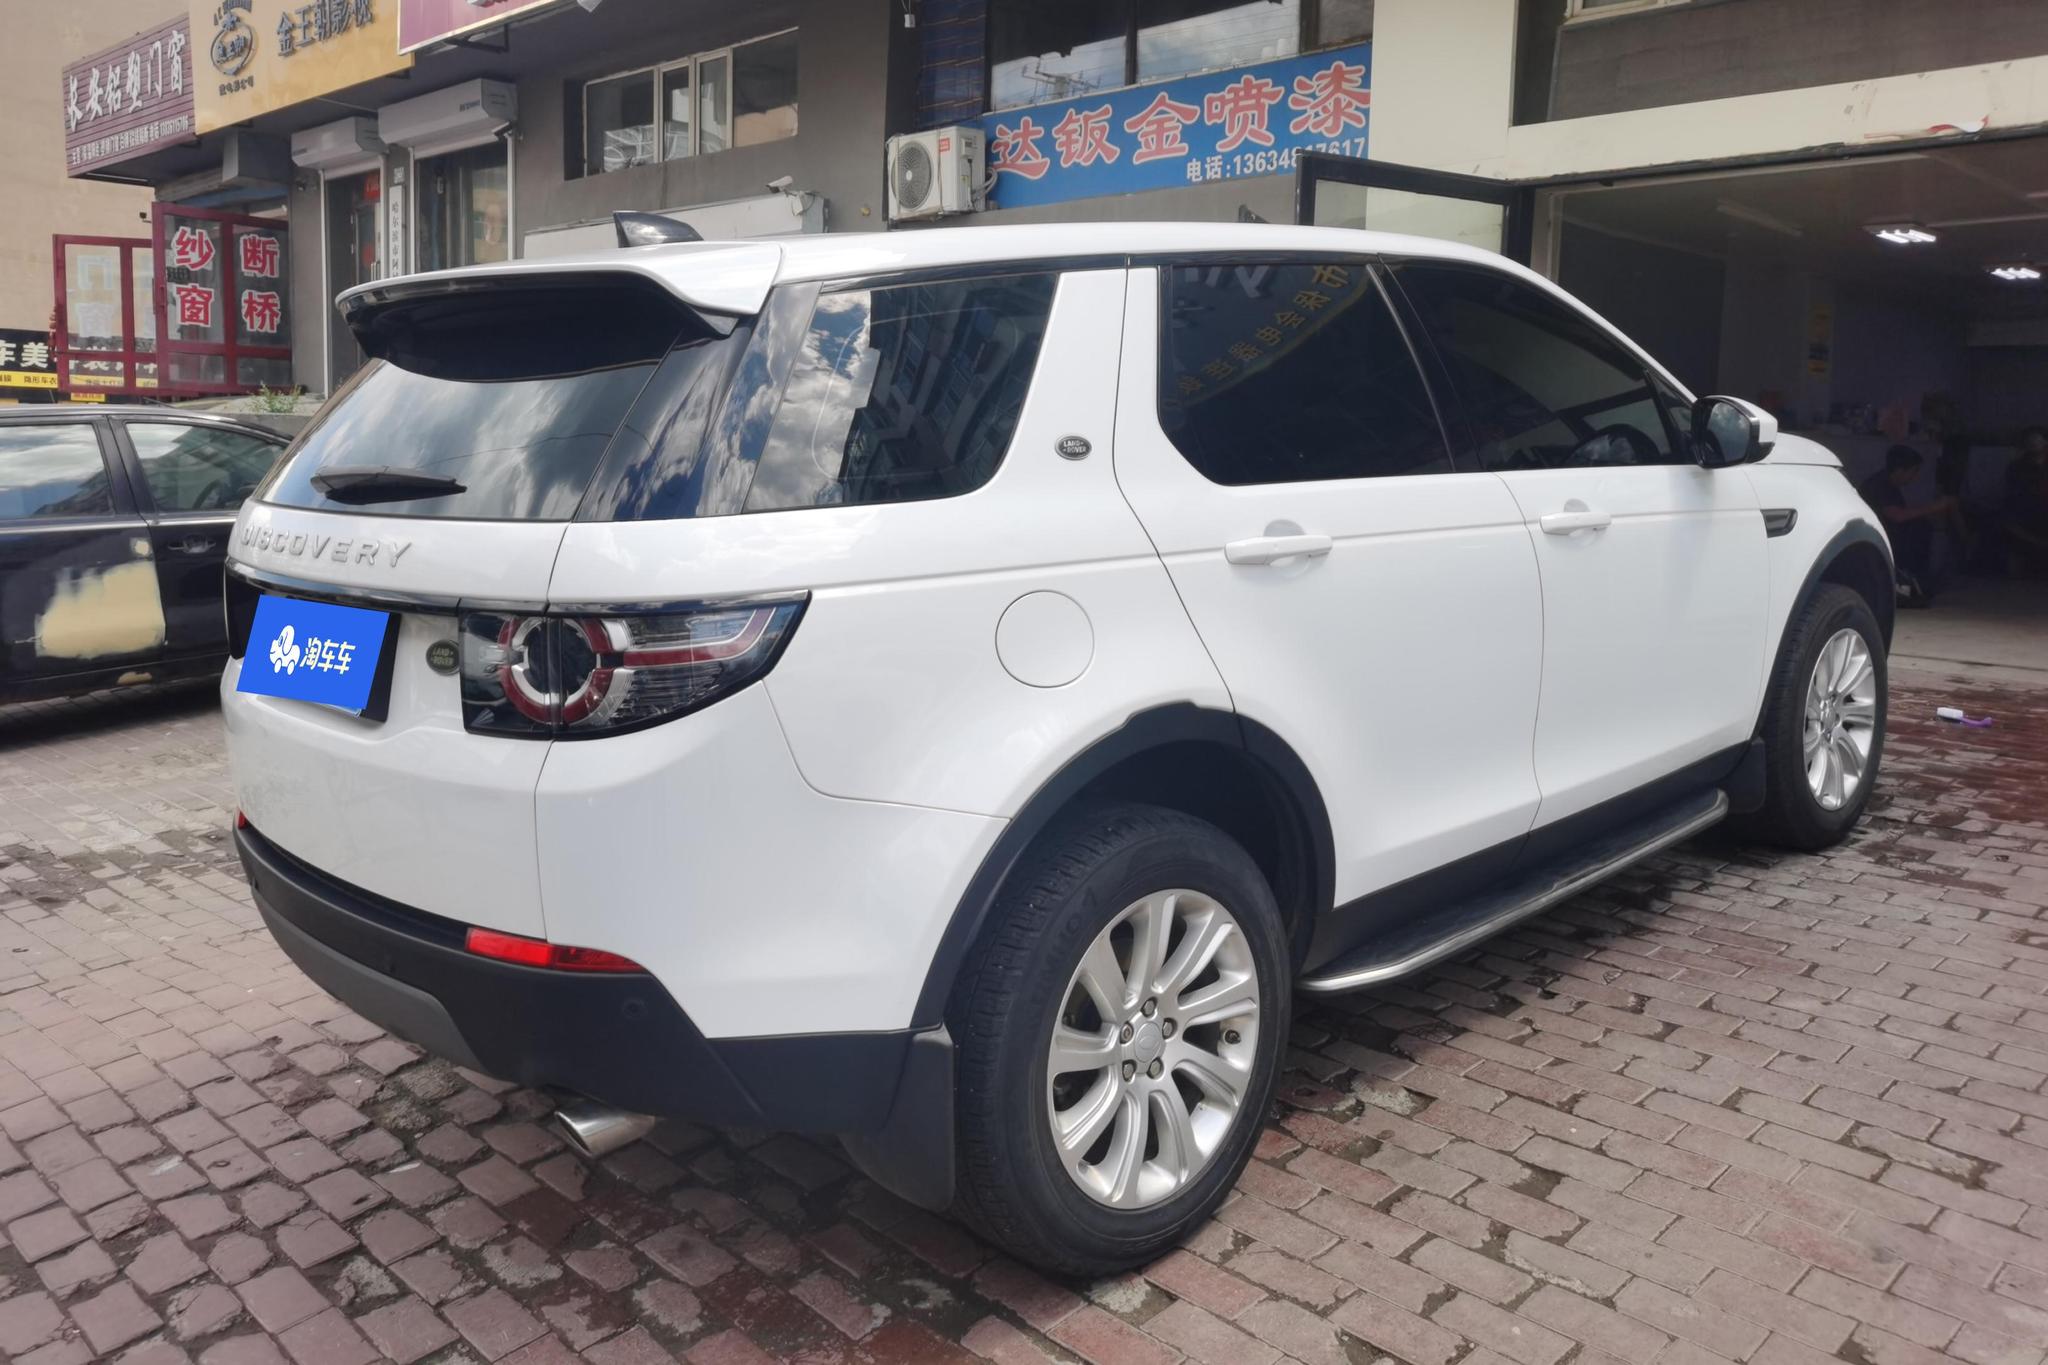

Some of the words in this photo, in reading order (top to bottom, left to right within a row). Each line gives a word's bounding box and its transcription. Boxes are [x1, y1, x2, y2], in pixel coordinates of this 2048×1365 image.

[67, 31, 185, 132] 长安铝塑门窗
[991, 61, 1370, 180] 达钣金喷漆
[171, 226, 216, 327] 纱窗
[240, 234, 281, 333] 断桥
[240, 524, 412, 568] DISCOVERY
